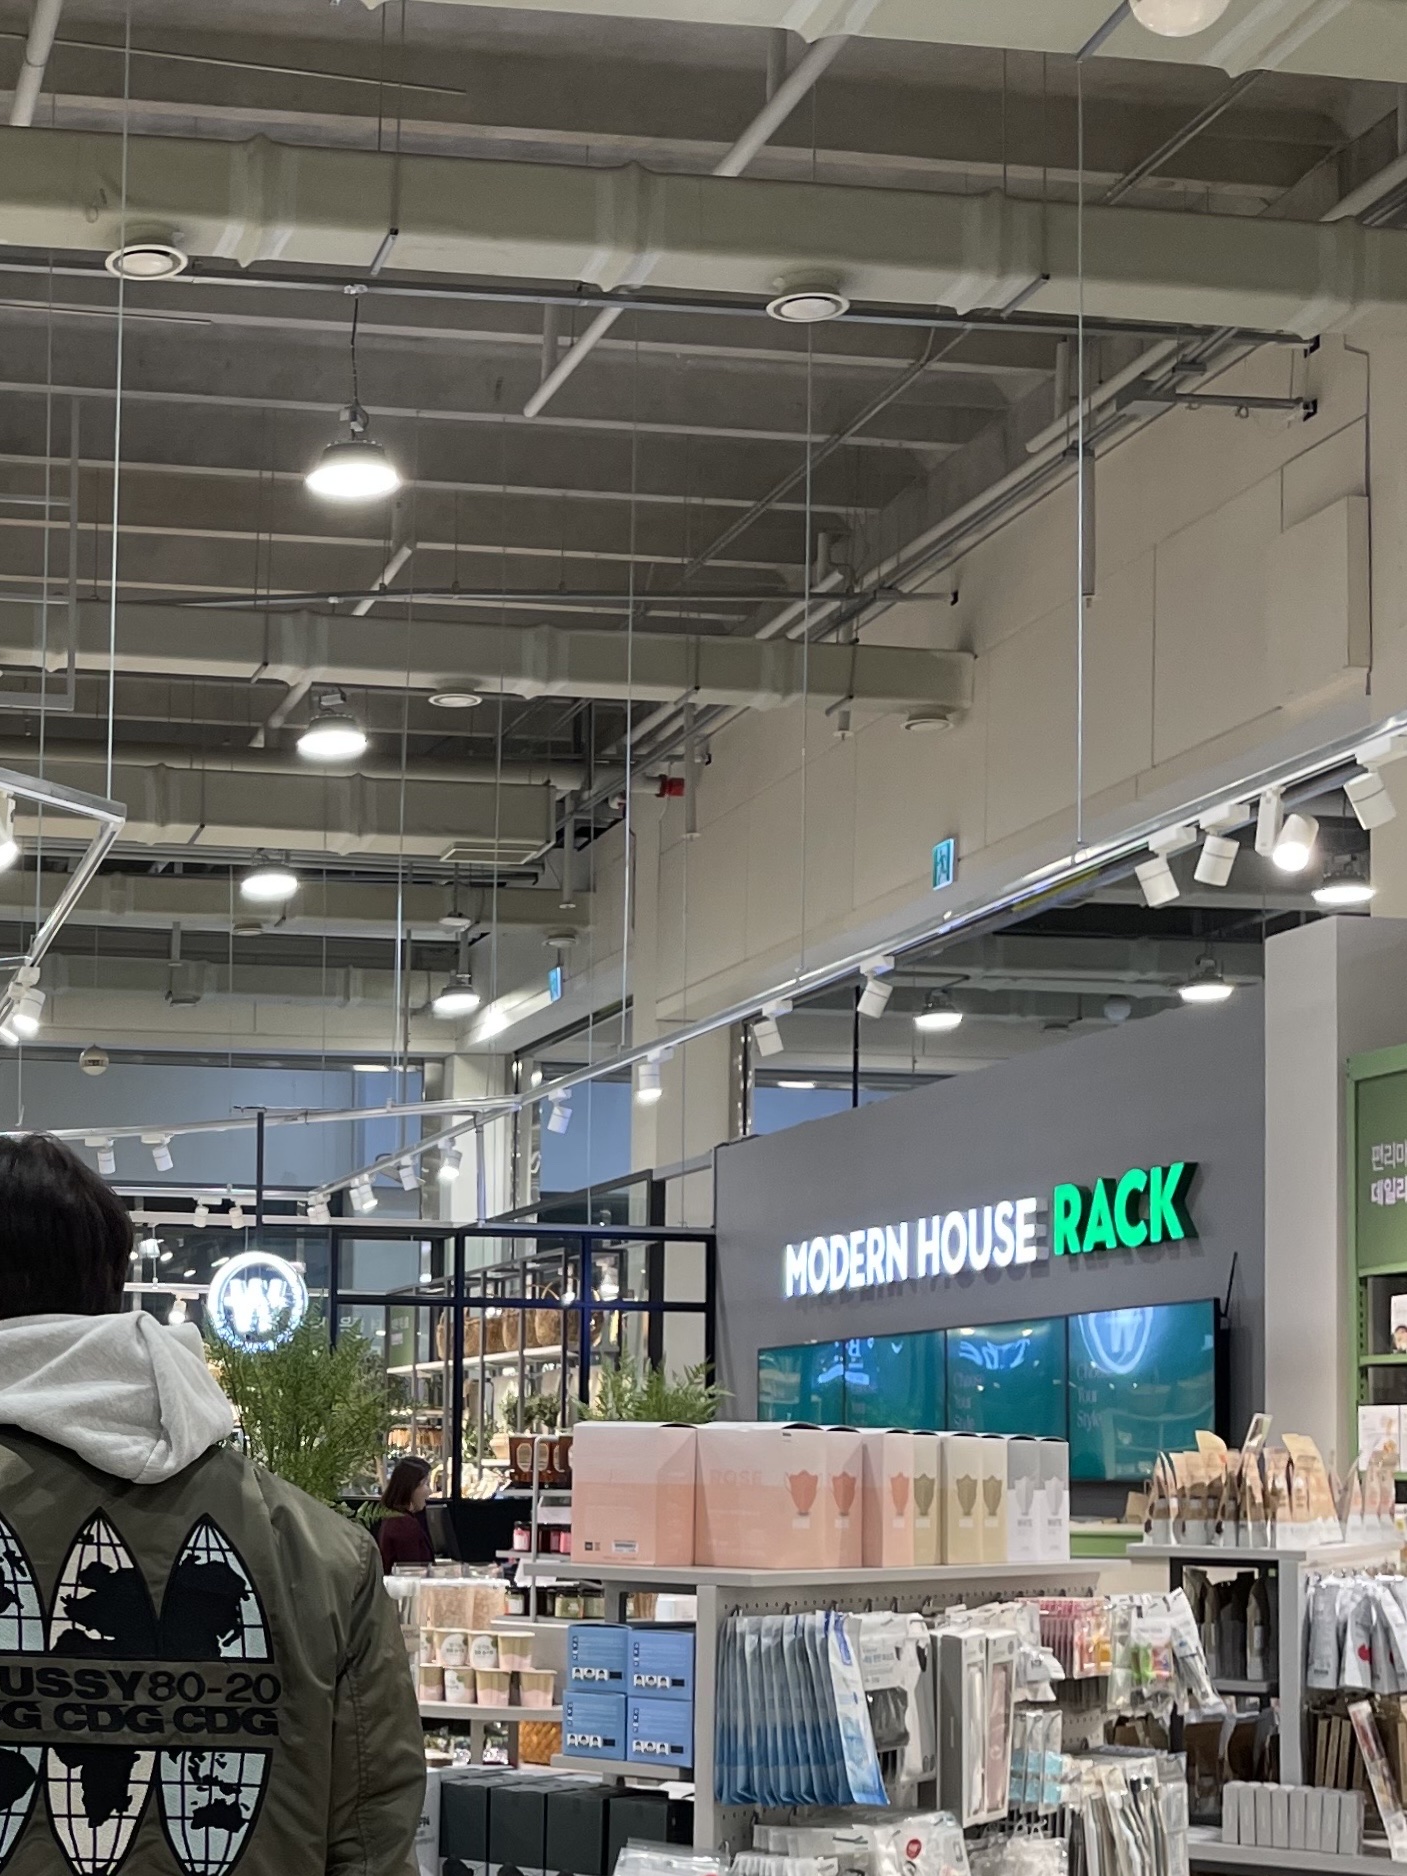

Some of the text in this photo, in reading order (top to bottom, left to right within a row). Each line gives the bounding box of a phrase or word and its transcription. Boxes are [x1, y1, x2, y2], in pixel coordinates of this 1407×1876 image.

[785, 1161, 1186, 1298] MODERN HOUSE RACK
[148, 1670, 282, 1704] 80-20
[53, 1703, 166, 1734] CDG
[173, 1705, 280, 1736] CDG
